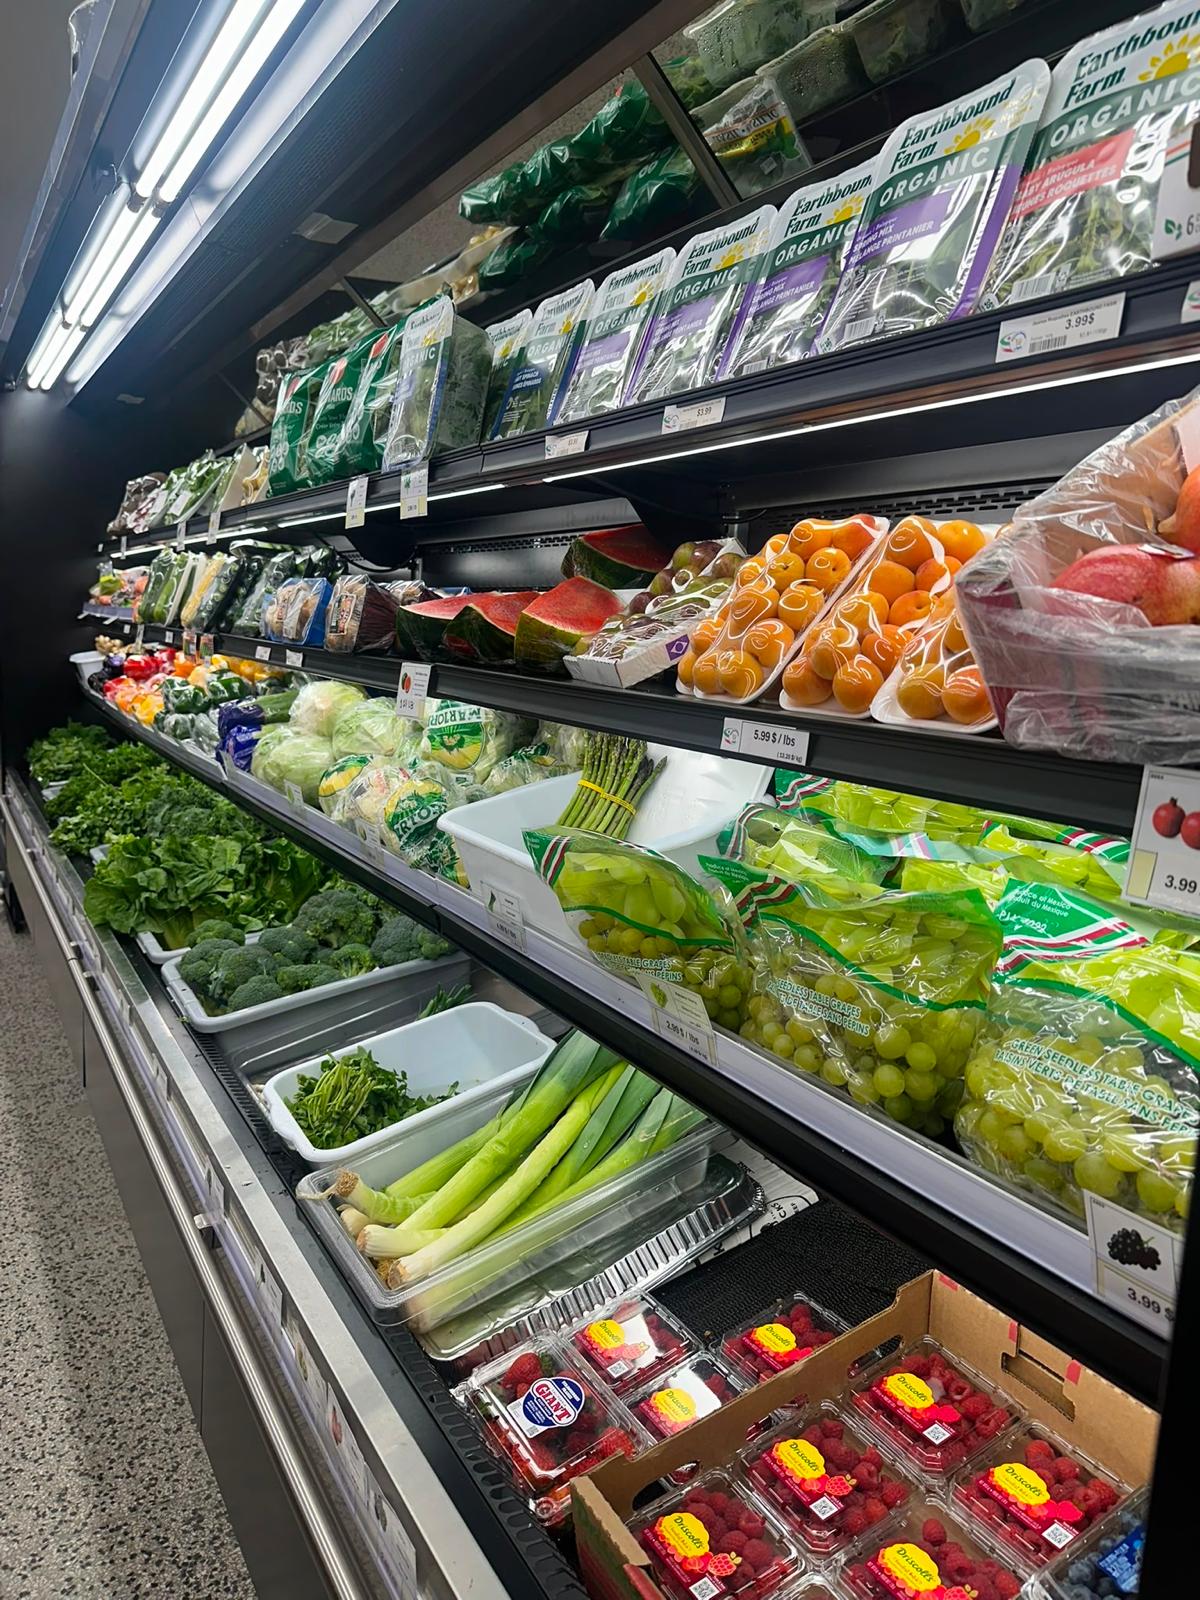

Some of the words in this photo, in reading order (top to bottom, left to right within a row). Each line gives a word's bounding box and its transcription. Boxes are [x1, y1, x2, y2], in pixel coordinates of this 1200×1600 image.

[1062, 67, 1126, 110] Farm
[899, 76, 1017, 150] Earthbound
[1050, 71, 1200, 148] ORGANIC
[890, 141, 938, 174] Farm
[879, 146, 990, 208] ORGANIC
[792, 174, 873, 218] Earthboun
[687, 216, 761, 260] Earthbound
[784, 212, 822, 239] Farm
[774, 219, 859, 267] ORGANIC
[681, 256, 712, 278] Farm
[674, 264, 739, 304] ORGANIC
[596, 303, 650, 333] ORGANIC
[1064, 312, 1096, 330] 3.99$
[753, 729, 771, 744] 5.99
[783, 734, 797, 747] lbs
[1164, 874, 1198, 894] 3.99
[1042, 903, 1070, 918] Mexique
[1048, 896, 1072, 910] Mexico
[643, 958, 672, 970] GRAPES
[809, 990, 830, 1007] TABLE
[830, 998, 861, 1019] GRAPES
[822, 1008, 842, 1026] SANS
[1011, 1039, 1043, 1056] GREEN
[1043, 1048, 1100, 1081] SEEDLESS
[1101, 1073, 1140, 1096] TABLE
[1028, 1060, 1062, 1082] VERTS
[1122, 1098, 1160, 1124] SANS
[1128, 1287, 1161, 1314] 3.99
[535, 1383, 572, 1422] GIANT
[896, 1546, 936, 1583] Driscoll's
